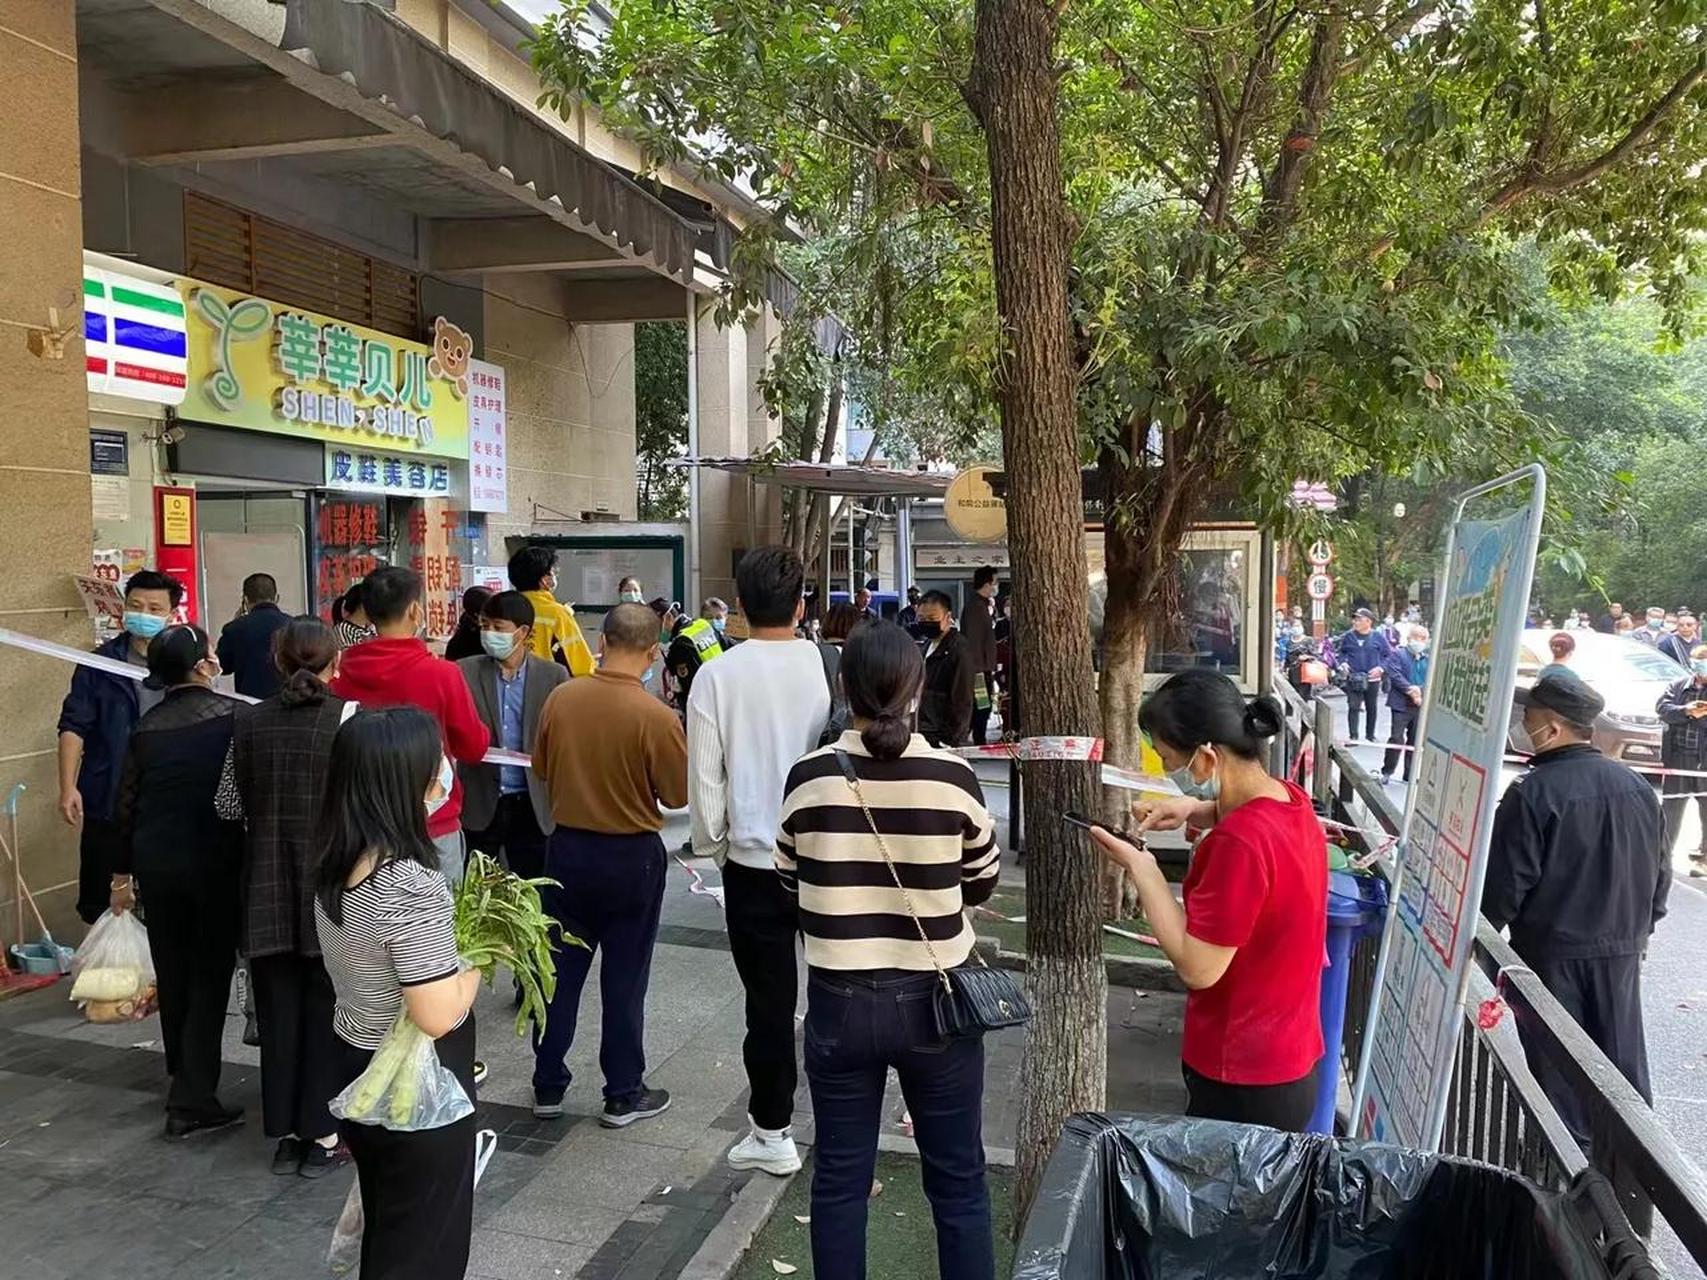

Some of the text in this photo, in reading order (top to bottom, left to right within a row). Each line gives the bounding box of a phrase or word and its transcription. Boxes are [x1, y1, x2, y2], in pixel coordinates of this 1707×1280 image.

[279, 313, 433, 409] 莘莘贝儿
[373, 405, 434, 446] SHEN
[331, 450, 448, 491] 皮鞋美容店
